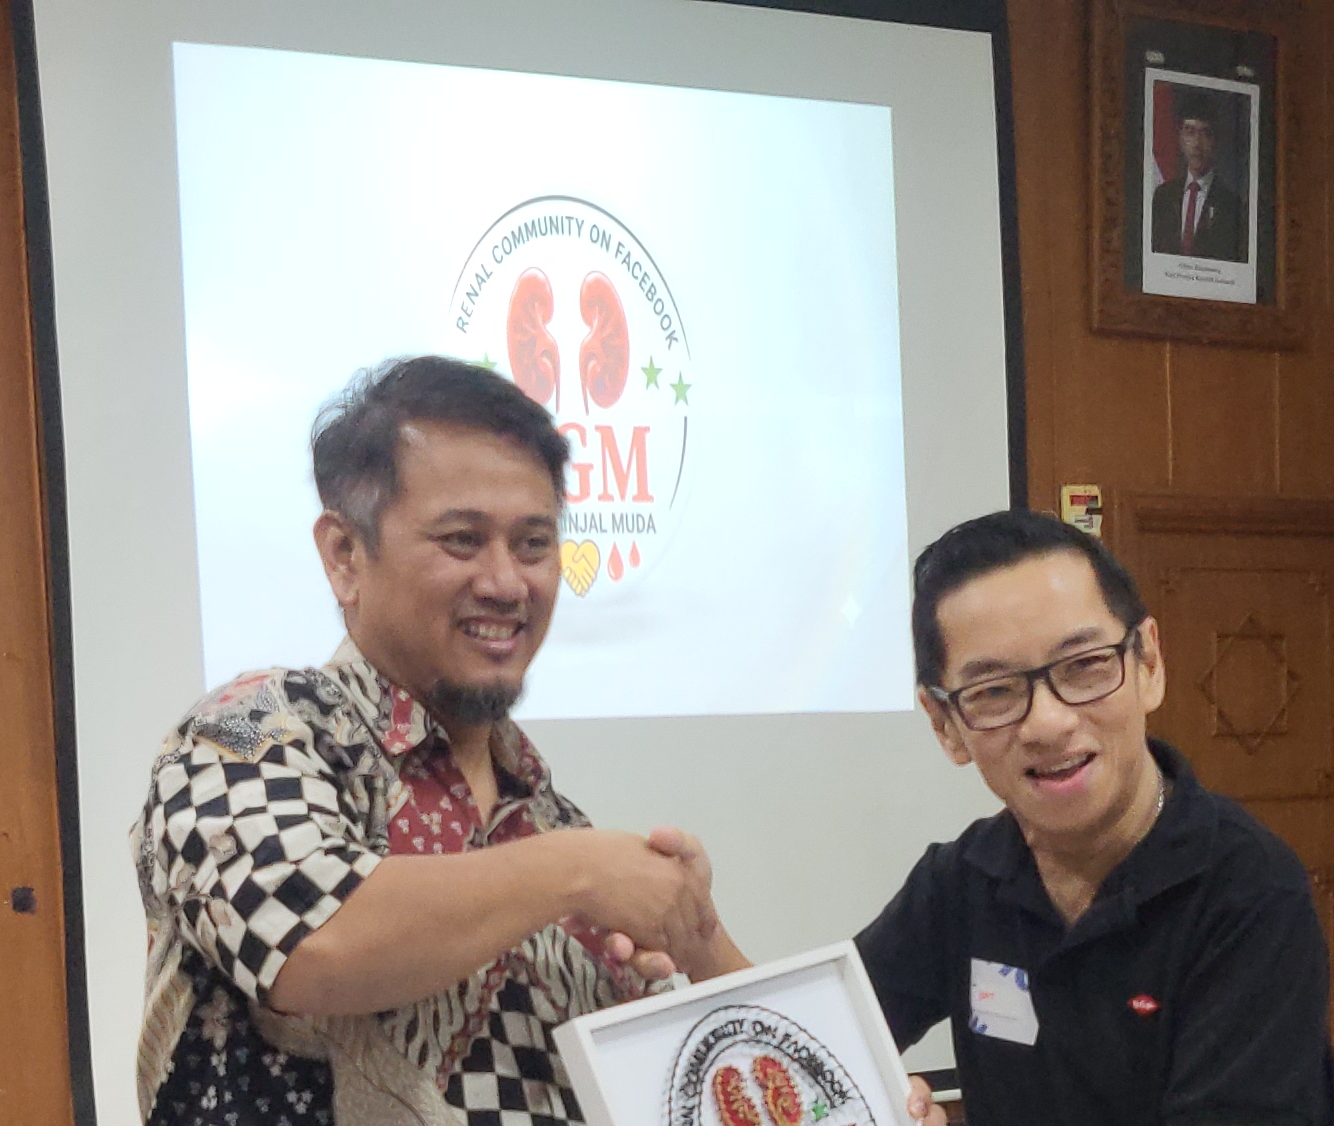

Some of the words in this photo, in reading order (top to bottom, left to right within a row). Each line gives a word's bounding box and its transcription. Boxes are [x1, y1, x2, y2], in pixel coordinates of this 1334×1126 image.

[456, 264, 493, 333] RENAL
[492, 215, 584, 264] COMMUNITY
[590, 224, 611, 253] ON
[615, 241, 679, 350] FACEBOOK
[556, 422, 654, 504] GM
[559, 512, 608, 534] INJAL
[611, 512, 657, 534] MUDA
